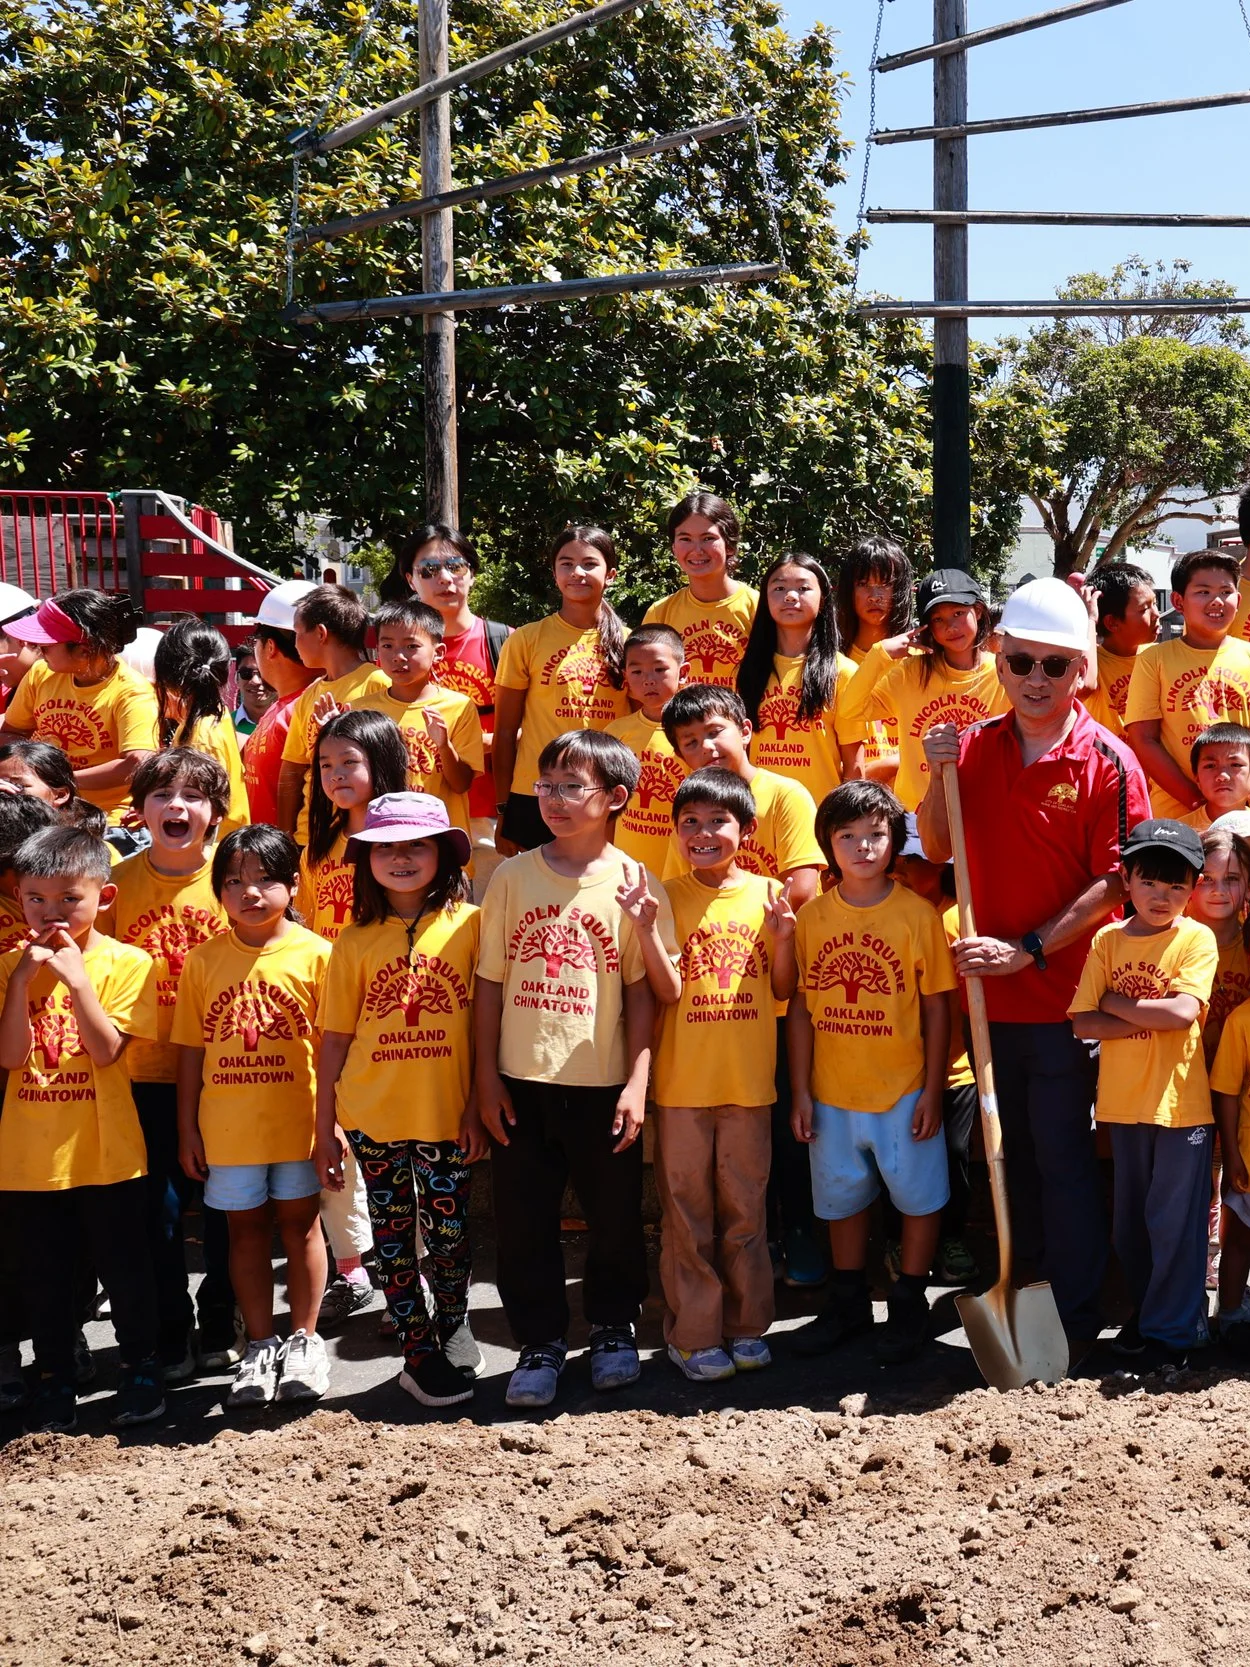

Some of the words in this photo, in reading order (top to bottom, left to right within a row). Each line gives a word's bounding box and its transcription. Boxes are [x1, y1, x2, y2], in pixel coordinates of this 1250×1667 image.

[1166, 666, 1209, 712] LINCOLN
[561, 697, 614, 709] OAKLAND
[555, 709, 616, 721] CHINATOWN
[909, 694, 956, 738] LINCOLN
[76, 701, 113, 750] SQUARE
[759, 743, 804, 754] OAKLAND
[508, 904, 561, 961] LINCOLN
[568, 906, 620, 974] SQUARE
[681, 921, 723, 982] LINCOLN
[726, 920, 769, 975] SQUARE
[806, 931, 854, 991] LINCOLN
[860, 933, 906, 994] SQUARE
[415, 953, 471, 1011] SQUARE
[521, 979, 590, 1000] OAKLAND
[514, 994, 596, 1017] CHINATOWN
[692, 992, 754, 1007] OAKLAND
[203, 980, 253, 1044] LINCOLN
[256, 980, 312, 1037] SQUARE
[686, 1008, 759, 1024] CHINATOWN
[824, 1006, 885, 1022] OAKLAND
[378, 1029, 447, 1046] OAKLAND
[817, 1020, 893, 1037] CHINATOWN
[219, 1055, 286, 1069] OAKLAND
[371, 1045, 453, 1063] CHINATOWN
[212, 1070, 295, 1085] CHINATOWN
